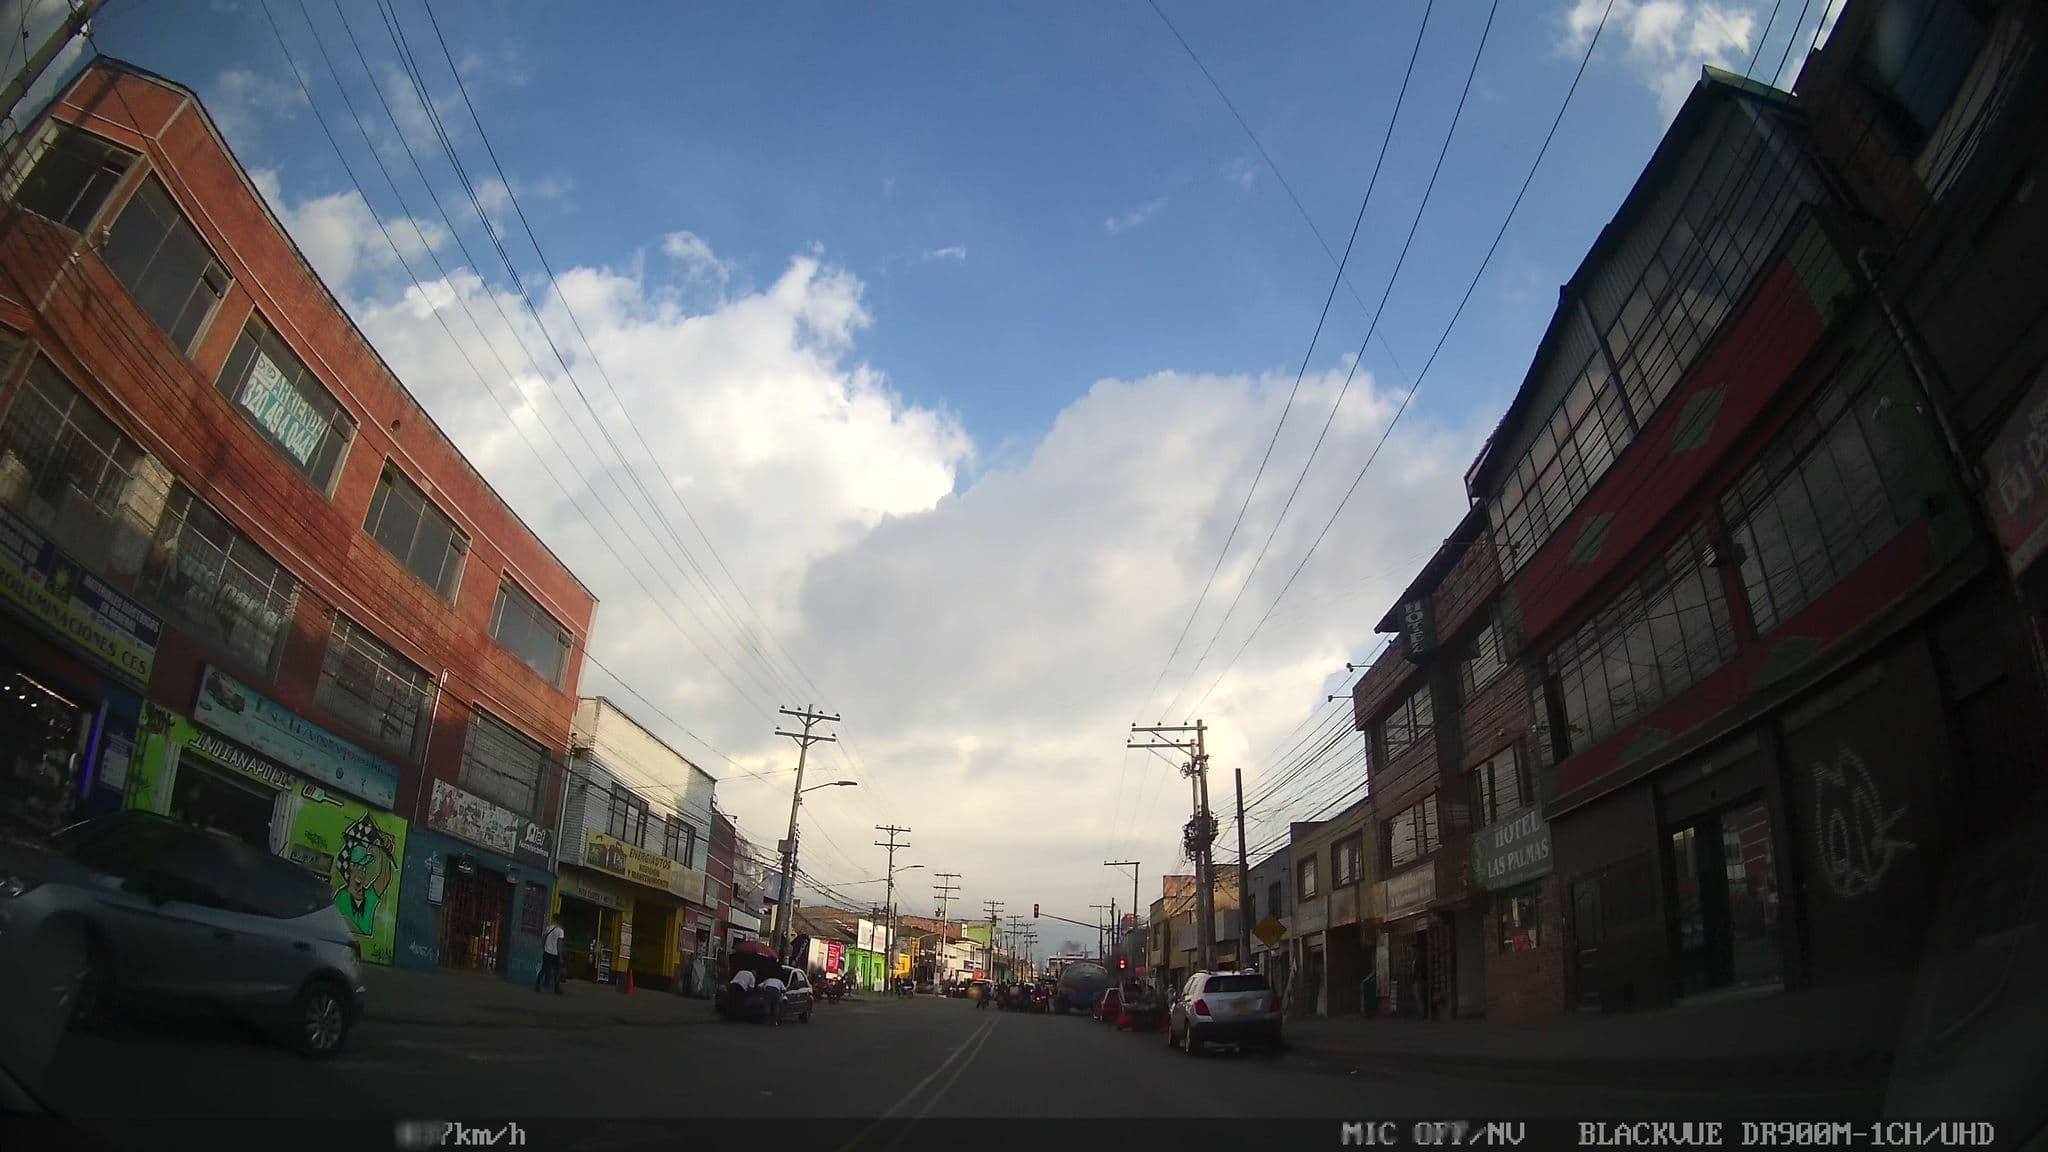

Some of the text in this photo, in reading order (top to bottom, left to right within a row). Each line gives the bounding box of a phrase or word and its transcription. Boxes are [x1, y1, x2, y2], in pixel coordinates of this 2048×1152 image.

[189, 730, 297, 791] INDIANAPOLIS
[1494, 811, 1540, 849] HOTEL
[1488, 838, 1549, 879] LAS PALMAS
